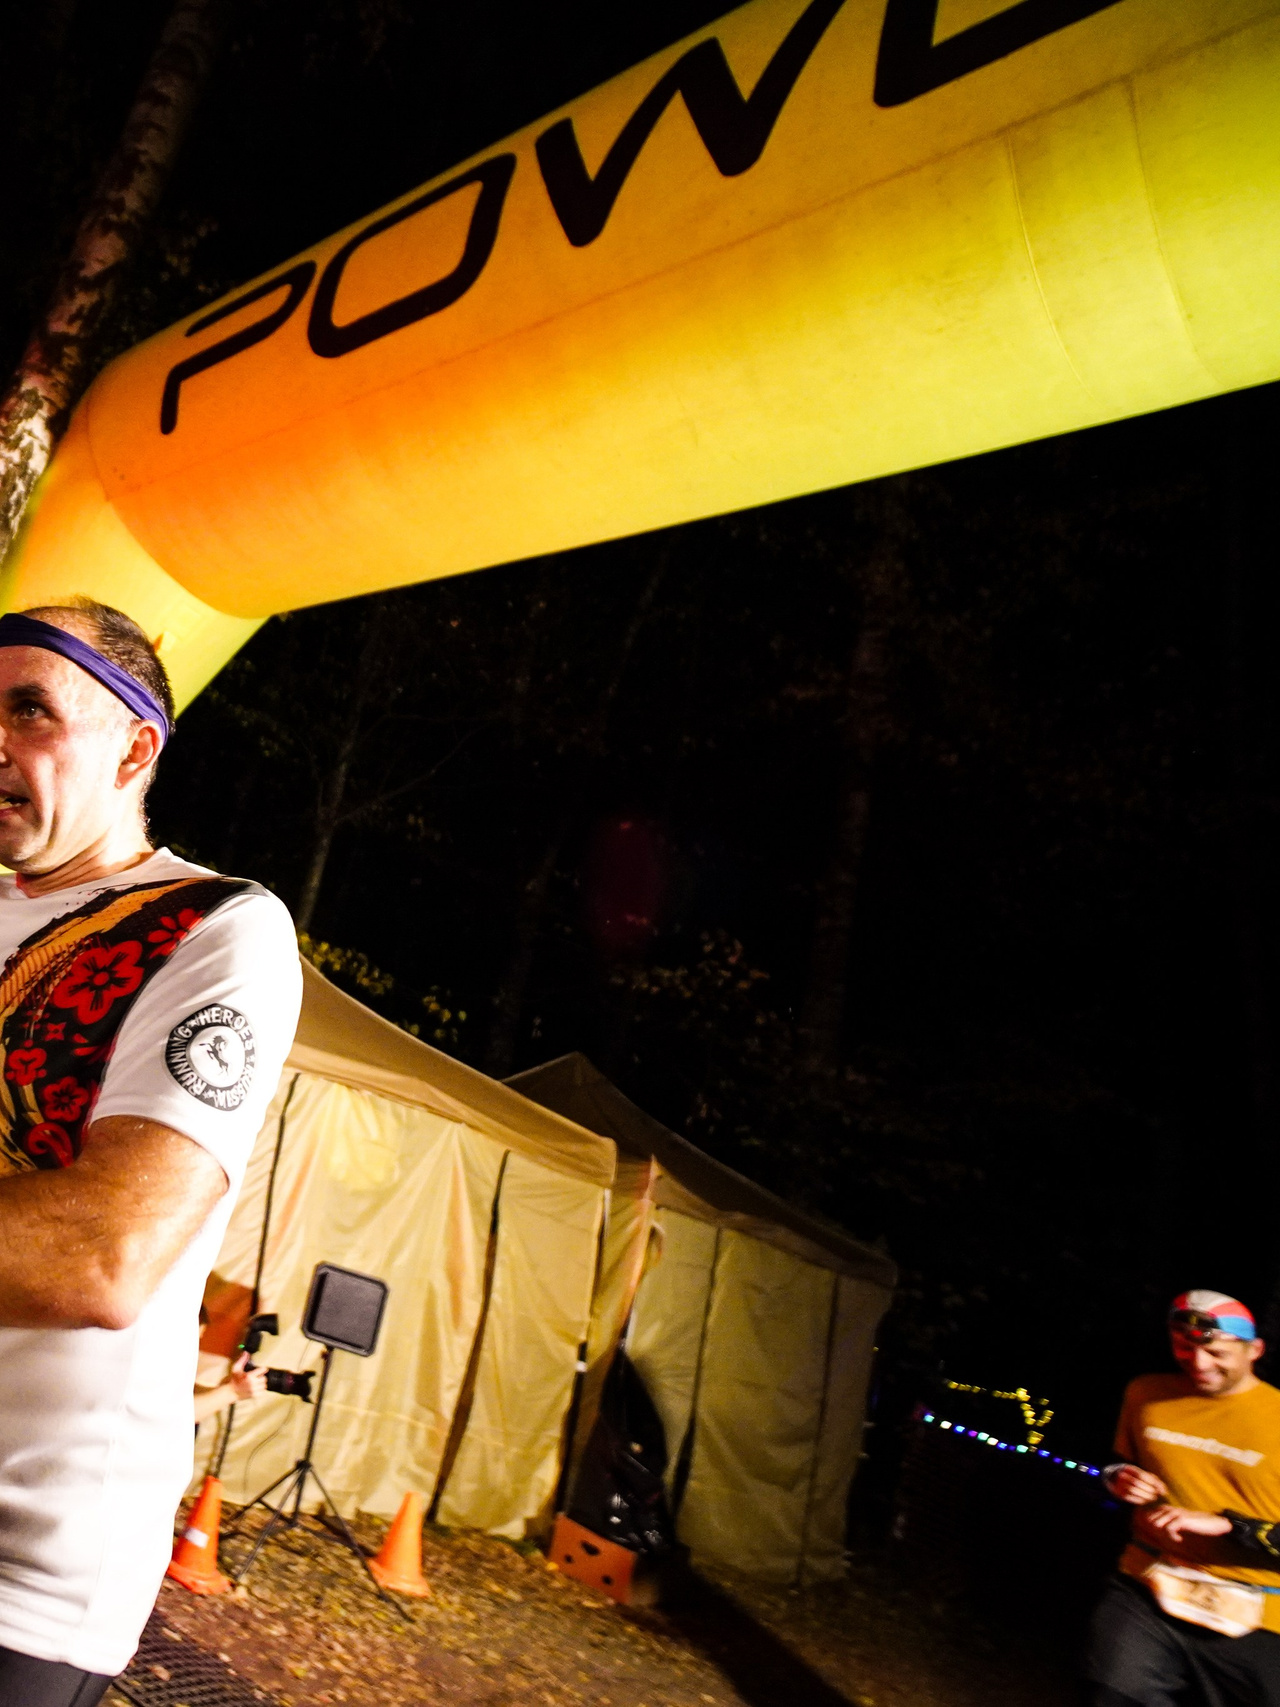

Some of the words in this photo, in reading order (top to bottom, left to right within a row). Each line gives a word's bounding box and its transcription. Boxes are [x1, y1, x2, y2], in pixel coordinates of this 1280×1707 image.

[198, 1006, 255, 1051] HEROES
[169, 1025, 208, 1097] RUNNING
[213, 1063, 255, 1109] RUSSIA
